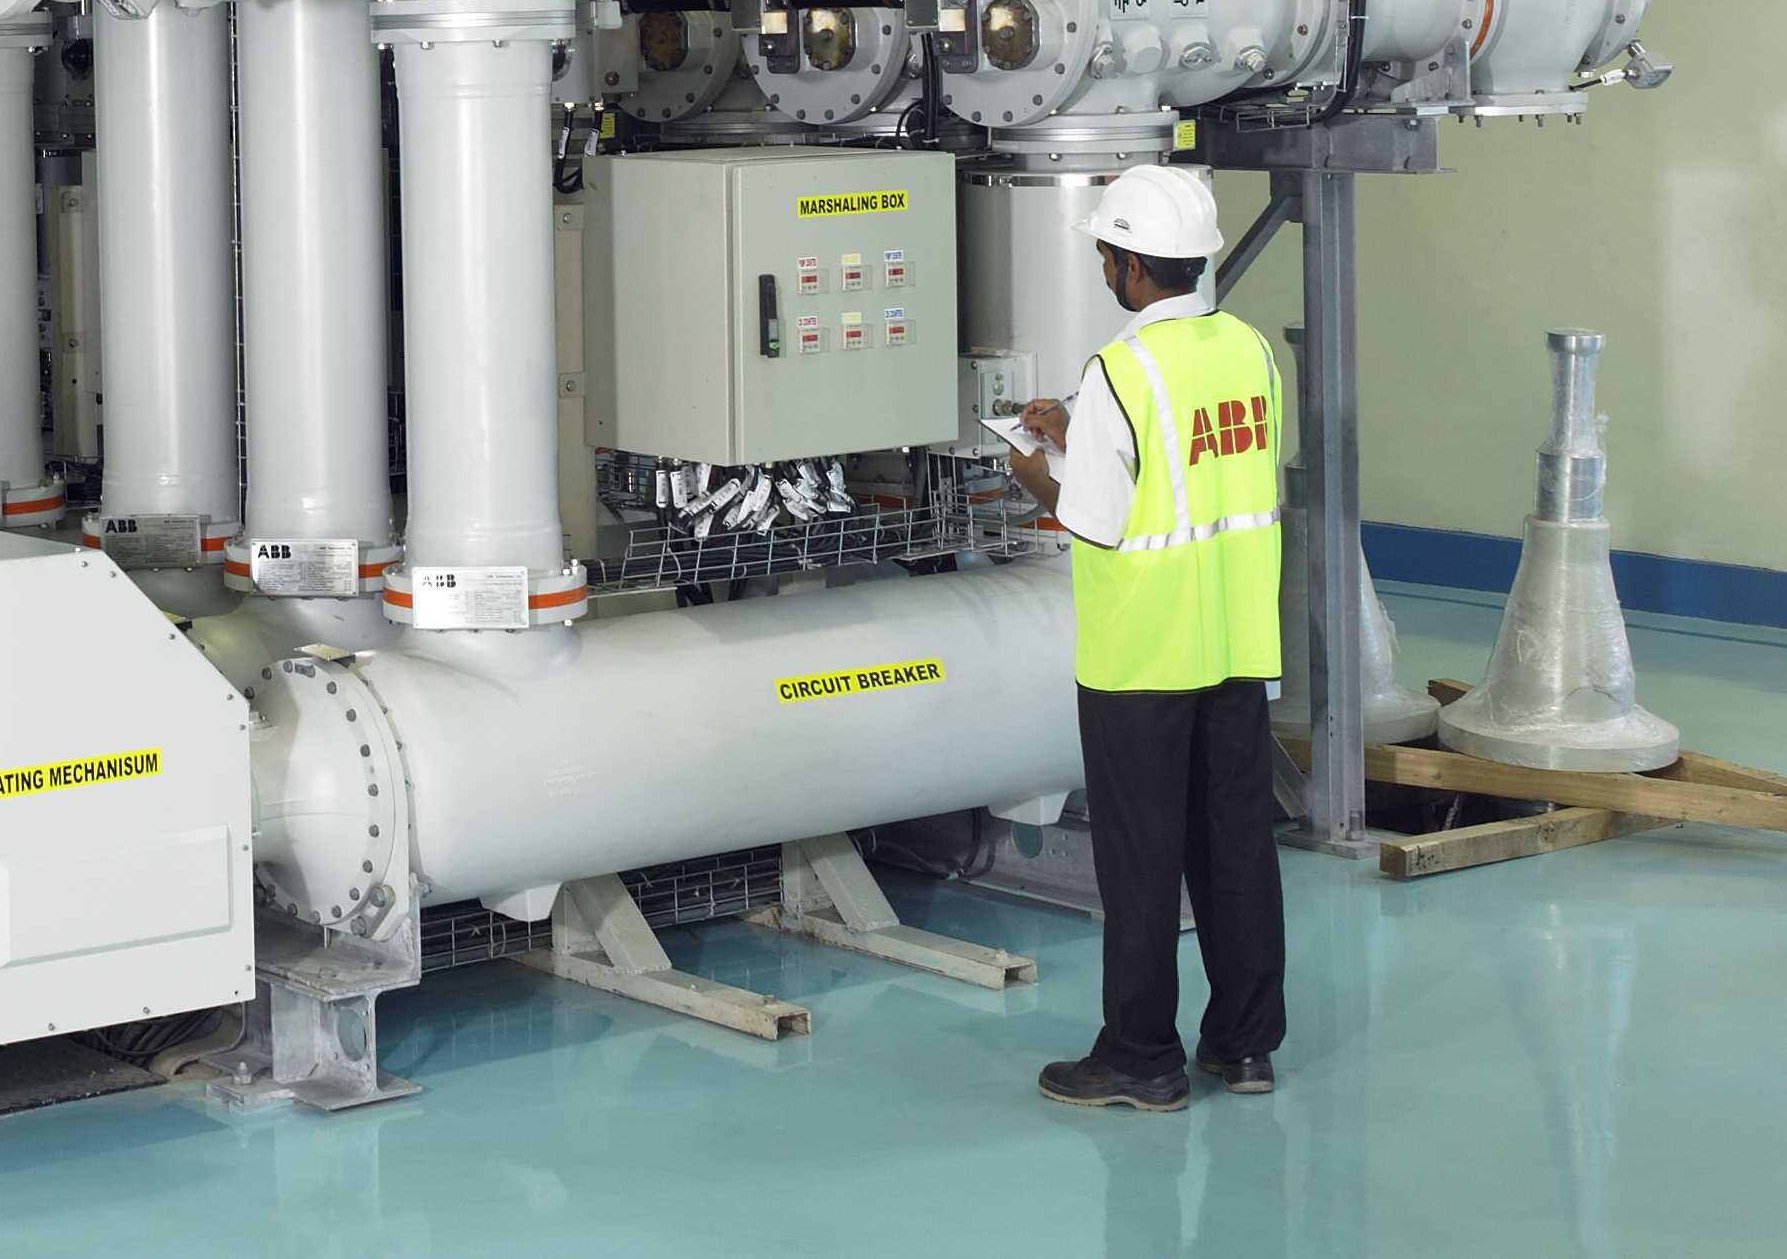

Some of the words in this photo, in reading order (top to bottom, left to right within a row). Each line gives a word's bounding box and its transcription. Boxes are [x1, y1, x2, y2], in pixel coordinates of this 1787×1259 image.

[799, 196, 878, 215] MARSHALING
[880, 193, 906, 211] BOX
[105, 519, 138, 533] ABB
[258, 544, 291, 559] ABB
[779, 675, 852, 701] CIRCUIT
[857, 662, 941, 690] BREAKER
[48, 753, 159, 788] MECHANISUM
